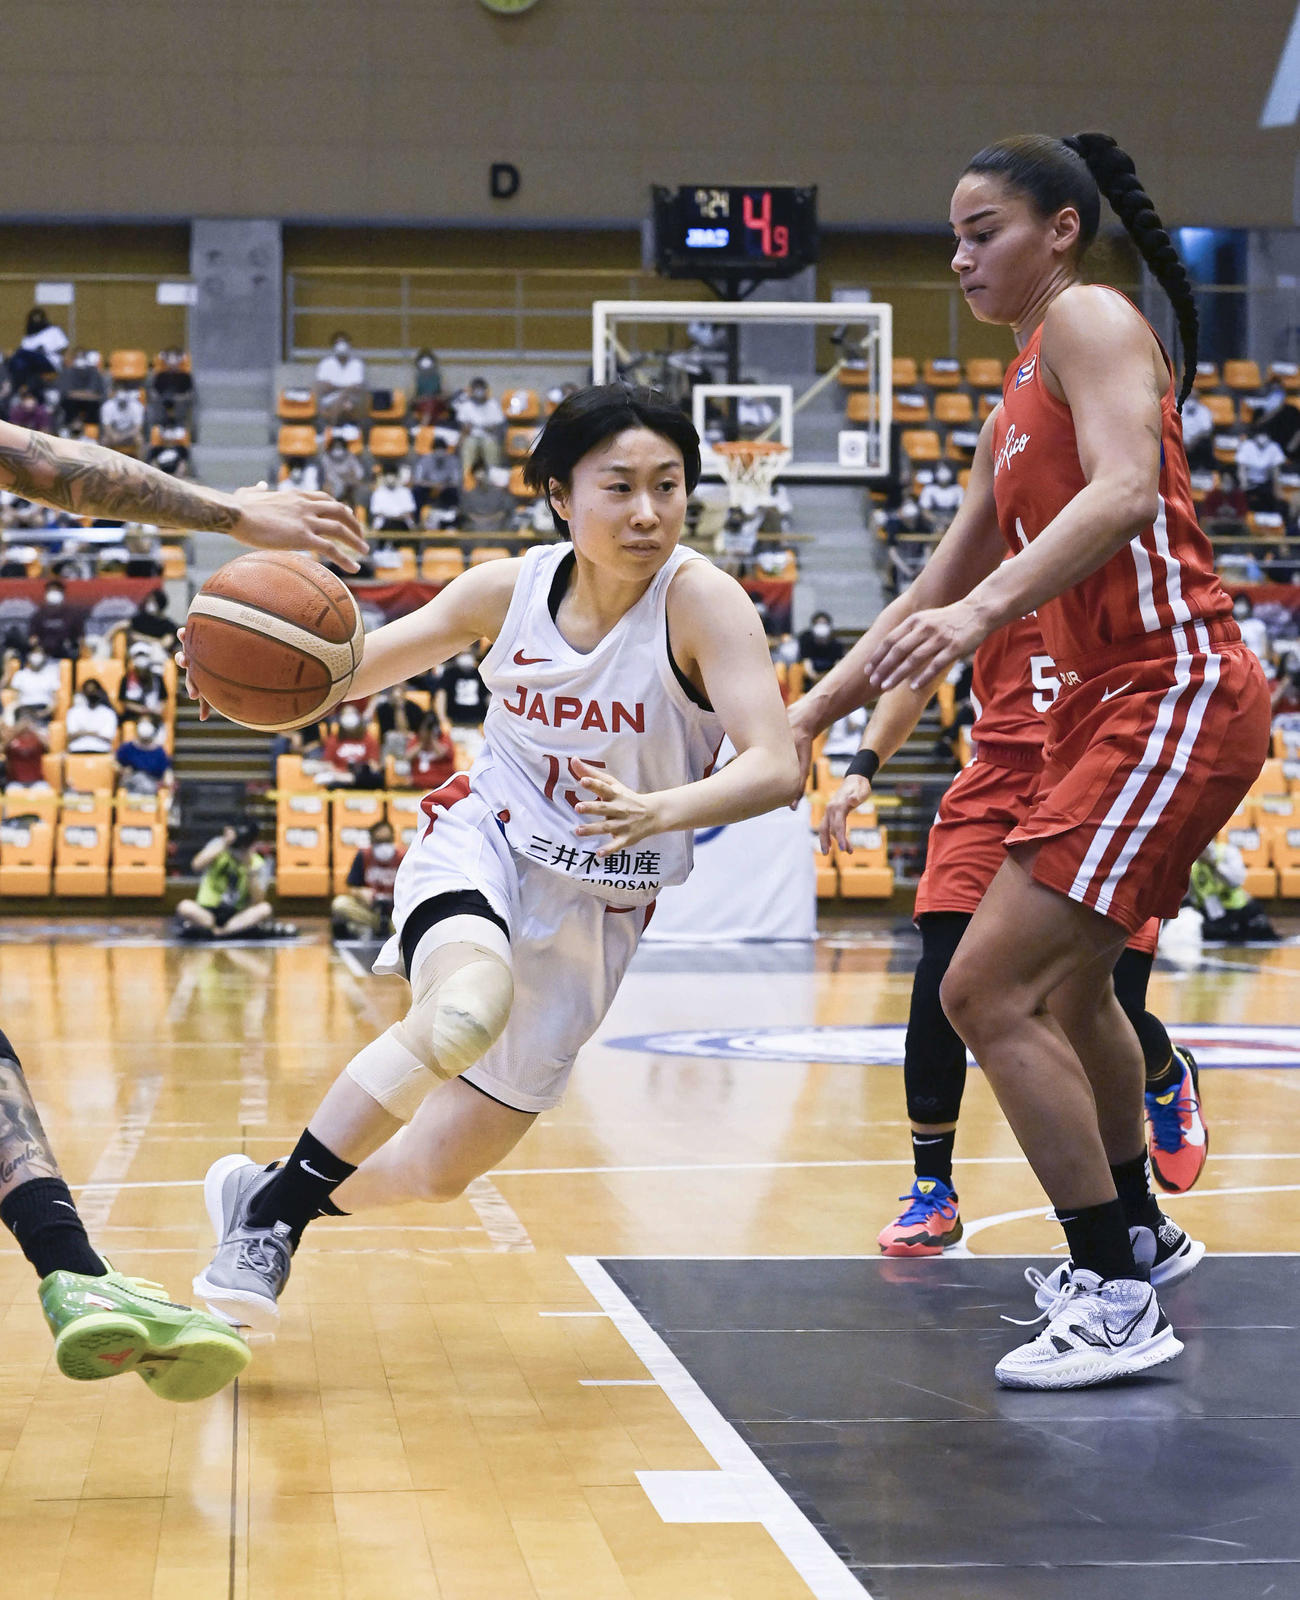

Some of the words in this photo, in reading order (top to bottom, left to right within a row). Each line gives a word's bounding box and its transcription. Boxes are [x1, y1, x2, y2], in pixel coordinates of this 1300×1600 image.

[490, 163, 520, 198] D
[1001, 423, 1031, 471] Rico
[503, 684, 645, 734] JAPAN
[542, 753, 607, 810] 15
[525, 834, 661, 876] 三井不動産
[582, 878, 660, 891] DOSAN
